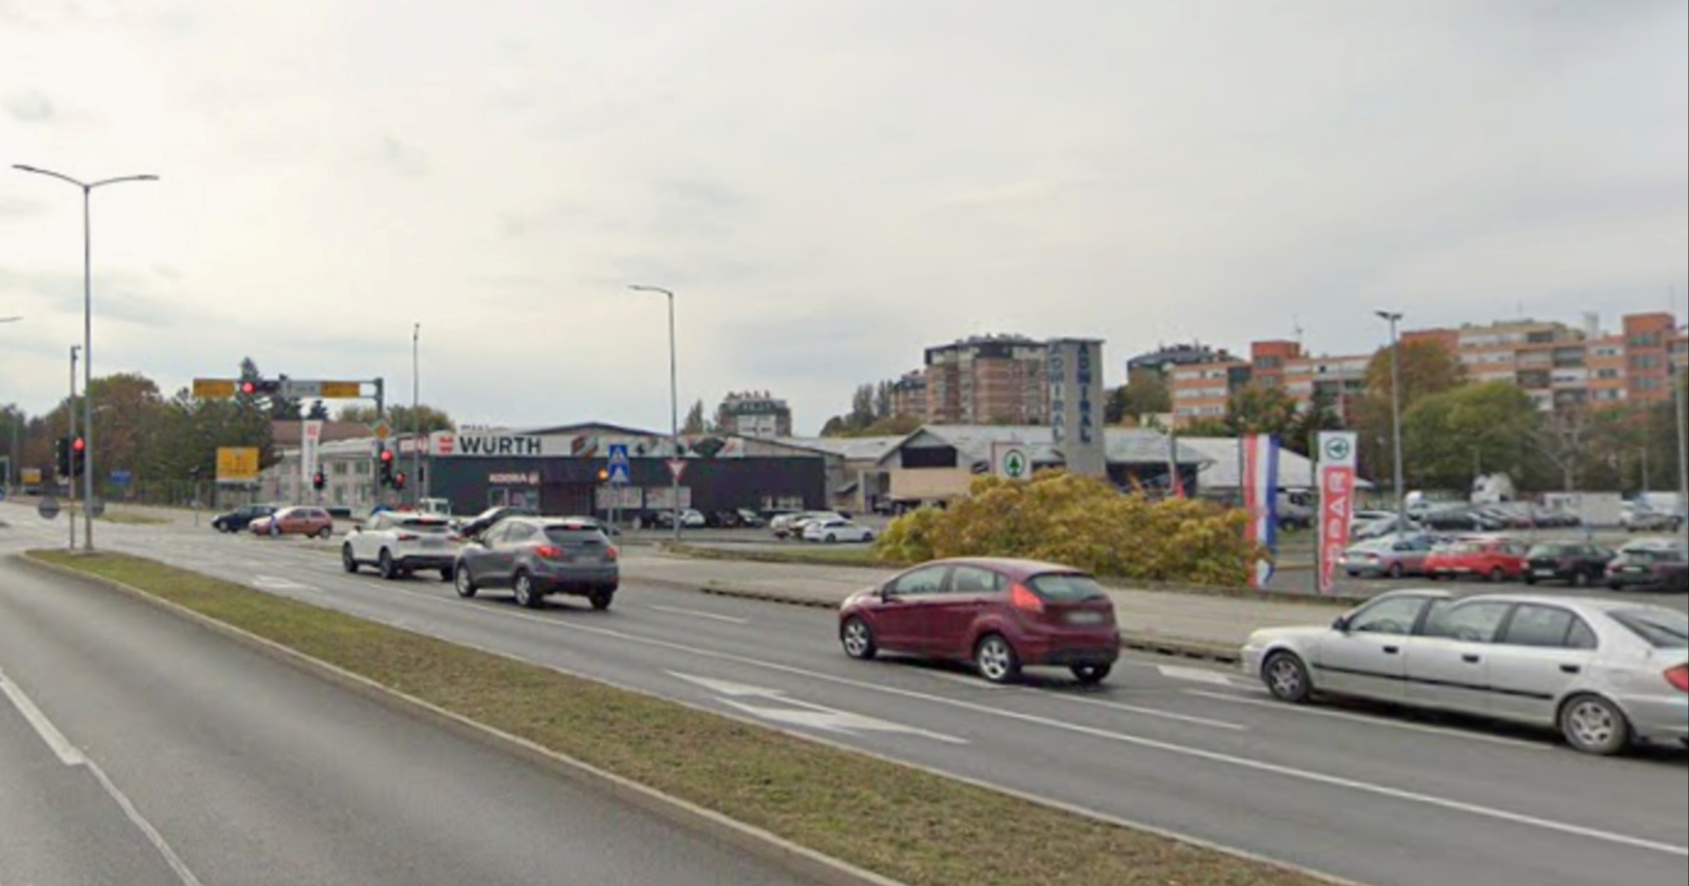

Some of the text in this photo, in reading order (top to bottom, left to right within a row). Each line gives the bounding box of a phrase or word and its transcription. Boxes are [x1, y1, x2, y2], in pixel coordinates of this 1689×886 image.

[1050, 343, 1065, 441] ADMIRAL
[1078, 342, 1092, 443] ADMIRAL
[459, 436, 542, 454] WÜRTH
